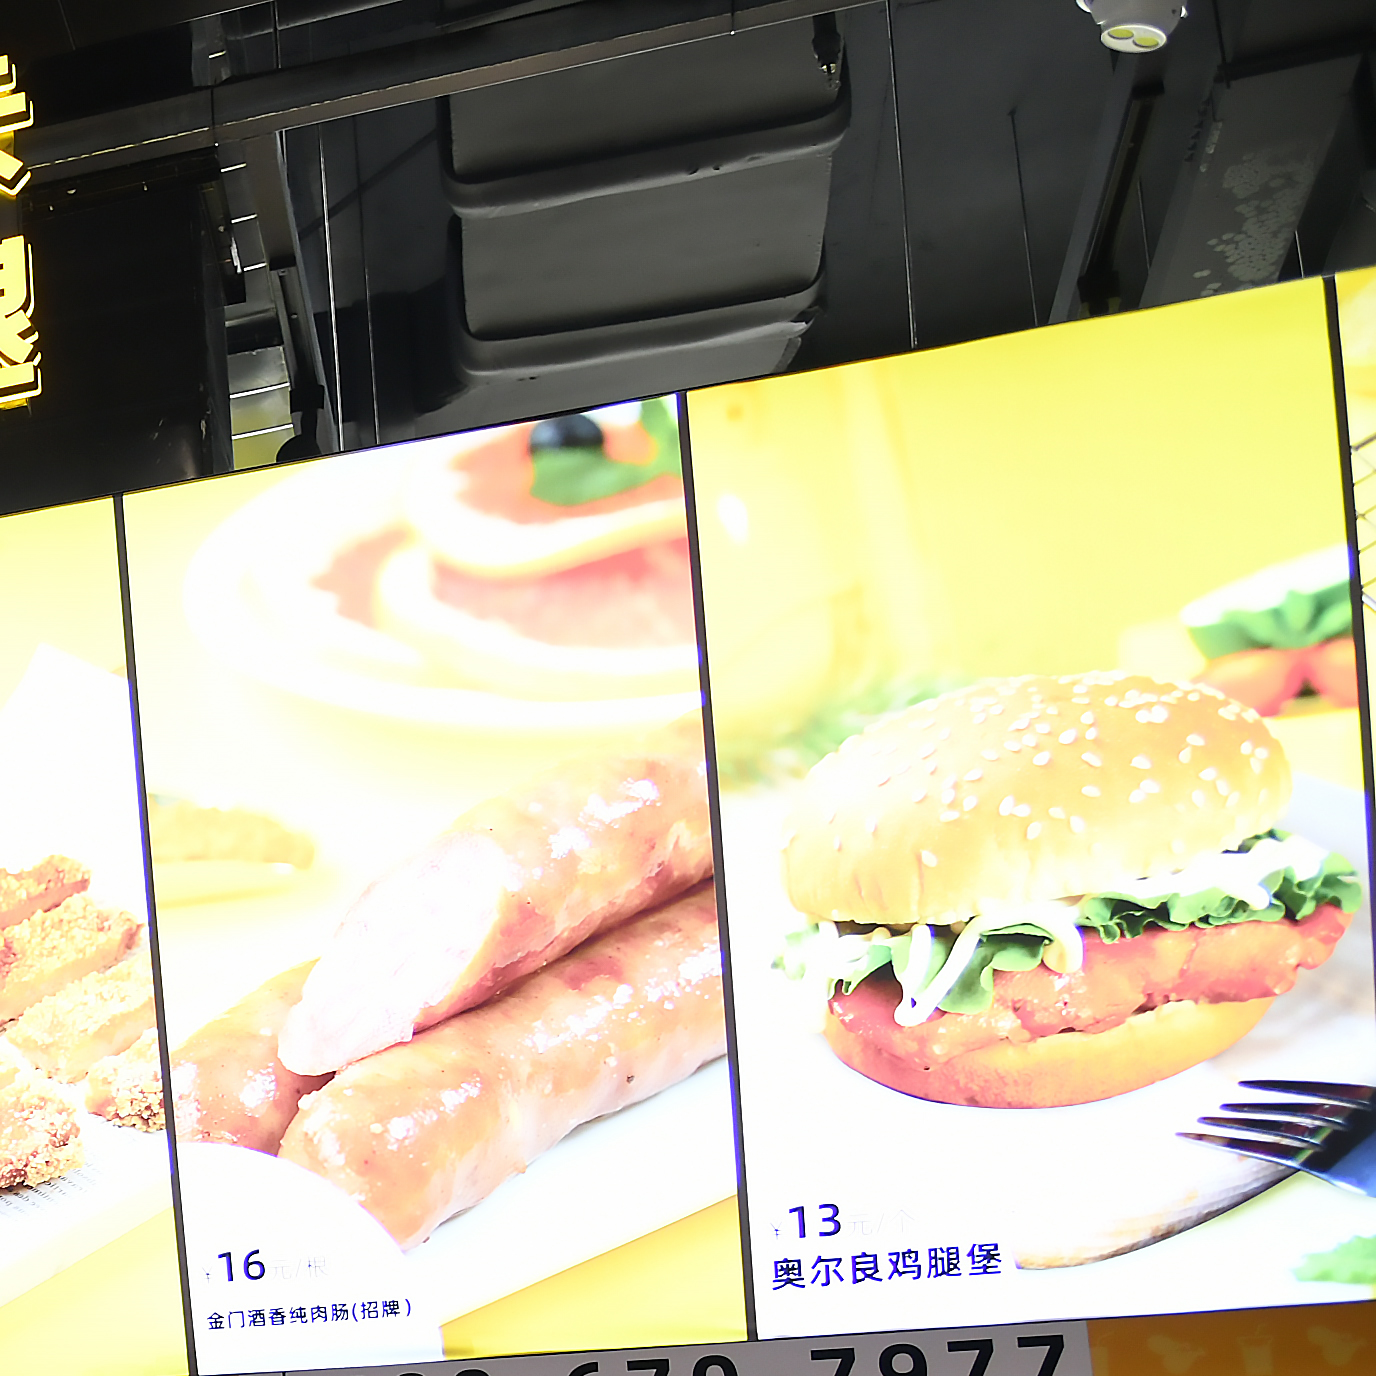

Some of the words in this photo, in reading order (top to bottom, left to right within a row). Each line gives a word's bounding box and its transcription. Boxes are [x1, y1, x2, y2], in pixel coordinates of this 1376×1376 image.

[772, 1243, 1002, 1291] 奥尔良鸡腿堡
[207, 1299, 411, 1330] 金门酒香纯肉肠(招牌)
